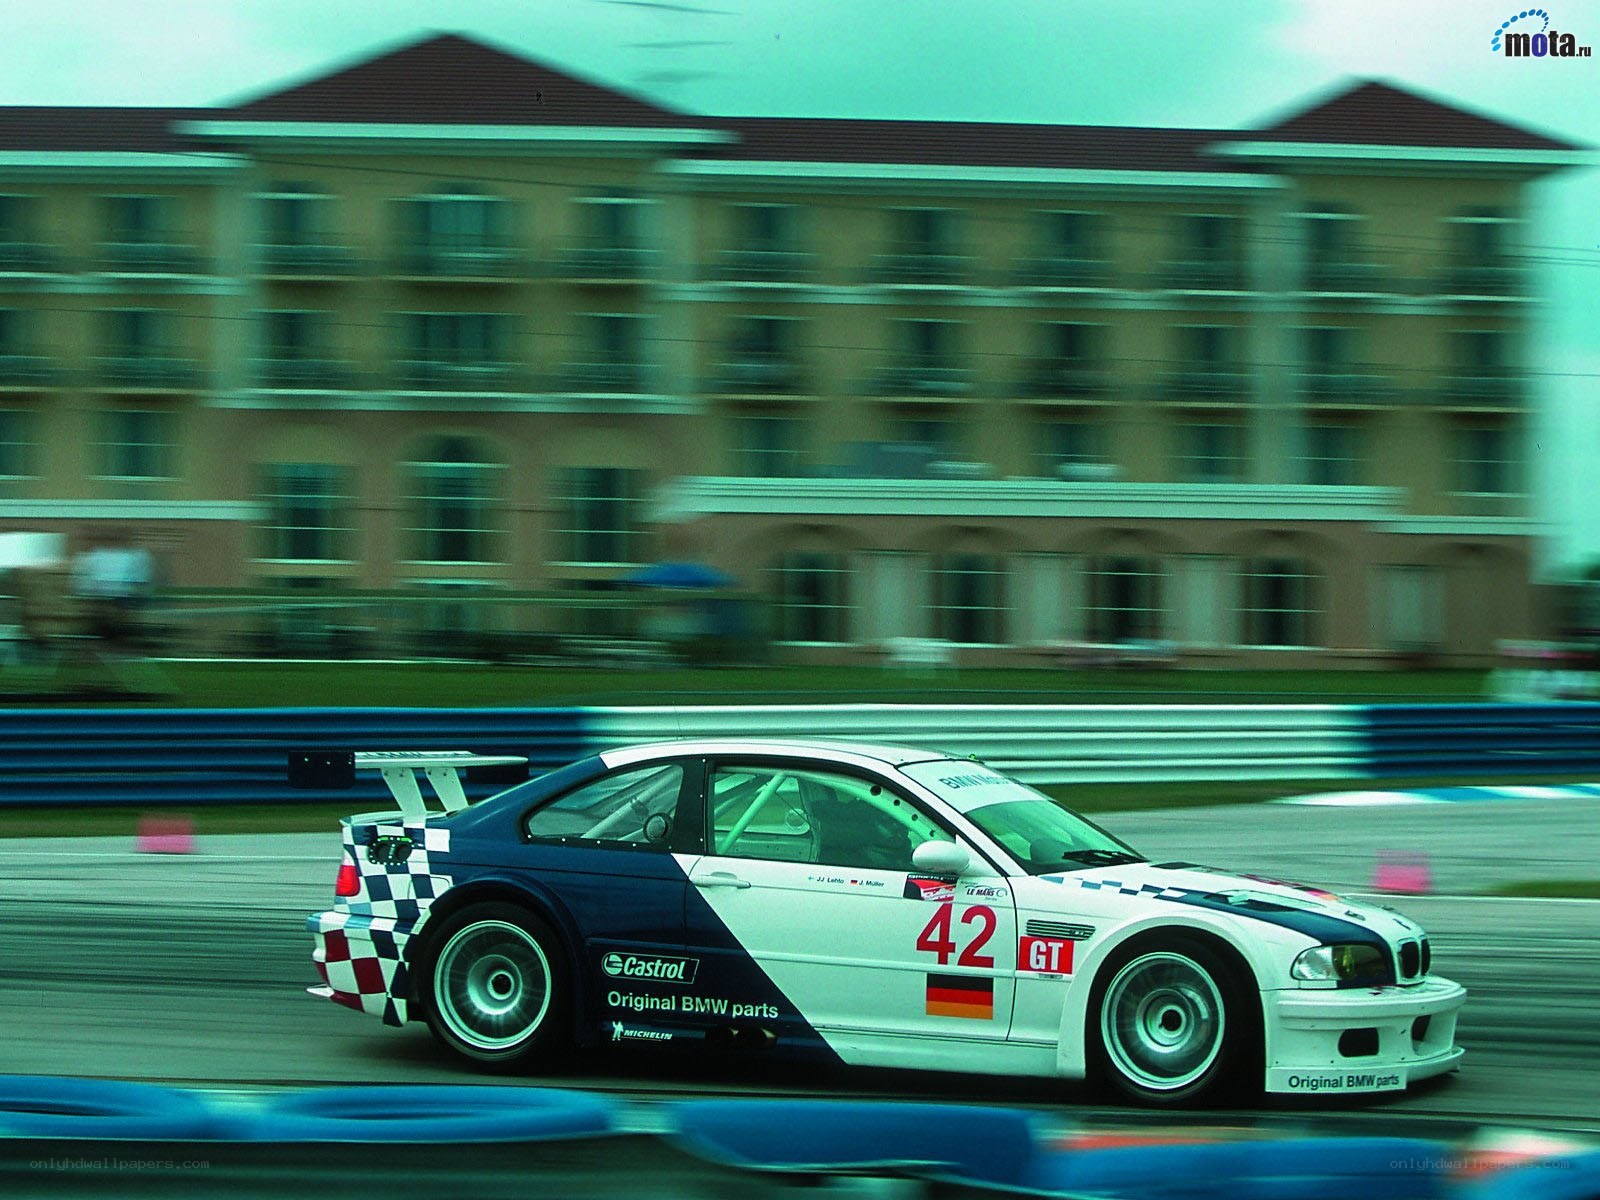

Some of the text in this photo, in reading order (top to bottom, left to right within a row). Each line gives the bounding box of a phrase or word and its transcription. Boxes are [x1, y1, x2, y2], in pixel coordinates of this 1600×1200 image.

[916, 902, 996, 968] 42
[624, 956, 685, 980] Castrol
[1029, 940, 1064, 971] GT
[608, 991, 779, 1019] Original BMW parts
[624, 1029, 673, 1040] MICHELIN
[1288, 1074, 1400, 1091] Original BMW parts
